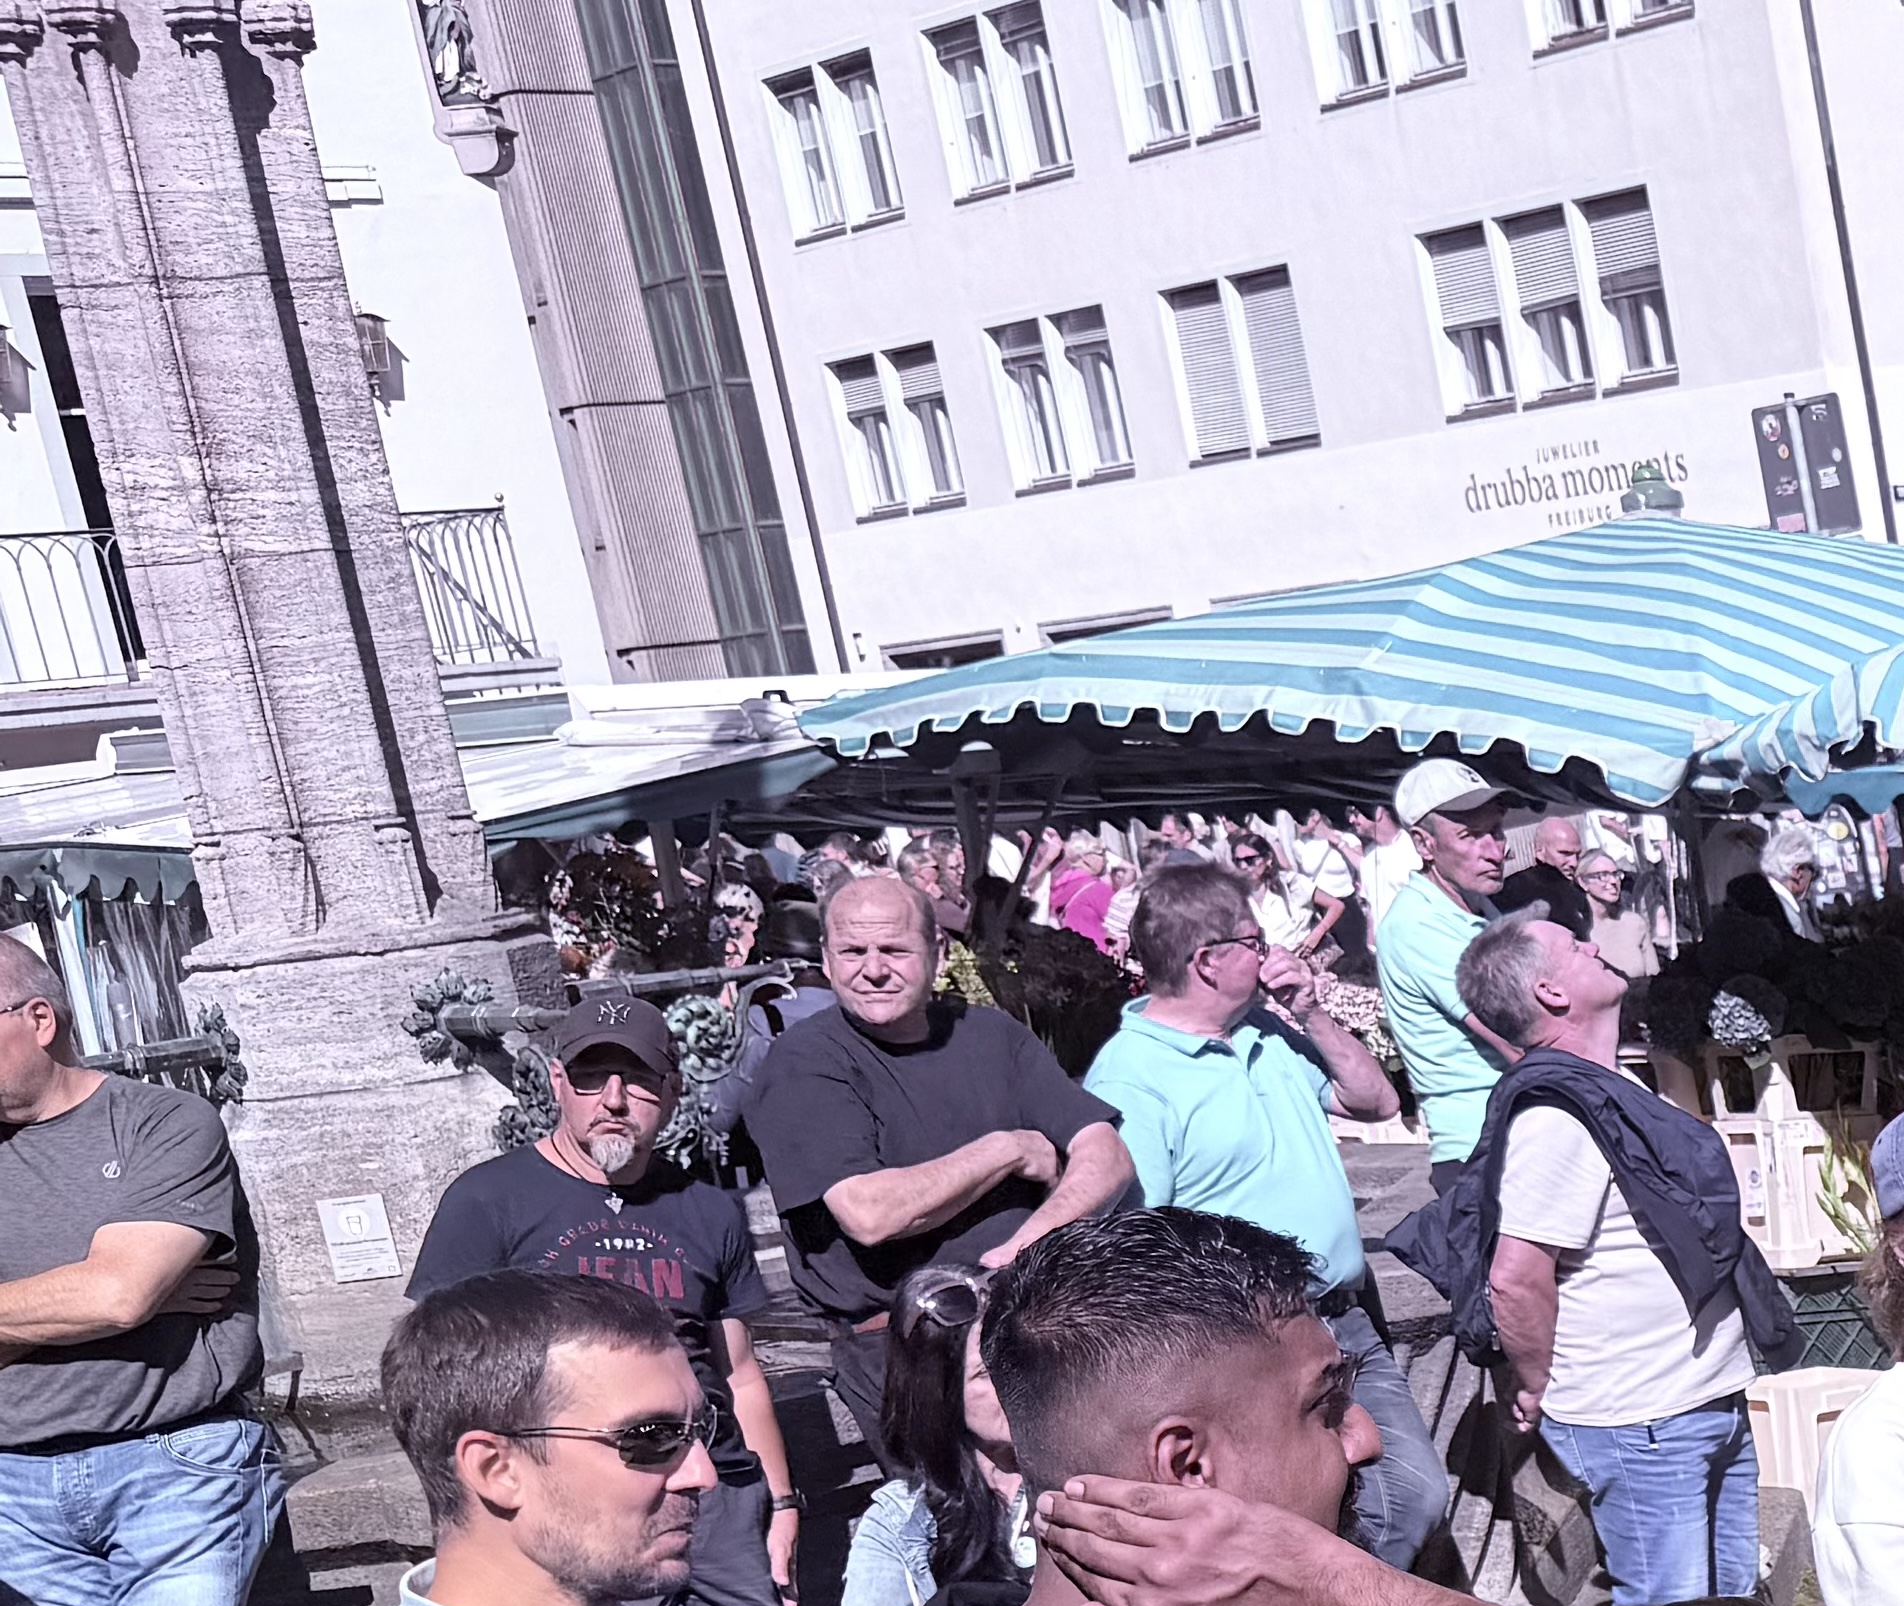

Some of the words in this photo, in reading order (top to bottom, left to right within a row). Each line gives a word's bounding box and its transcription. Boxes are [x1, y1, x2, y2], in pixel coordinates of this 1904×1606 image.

[1536, 439, 1600, 464] JUWELIER
[1465, 465, 1558, 513] drubba
[1548, 504, 1612, 528] FREIBURG
